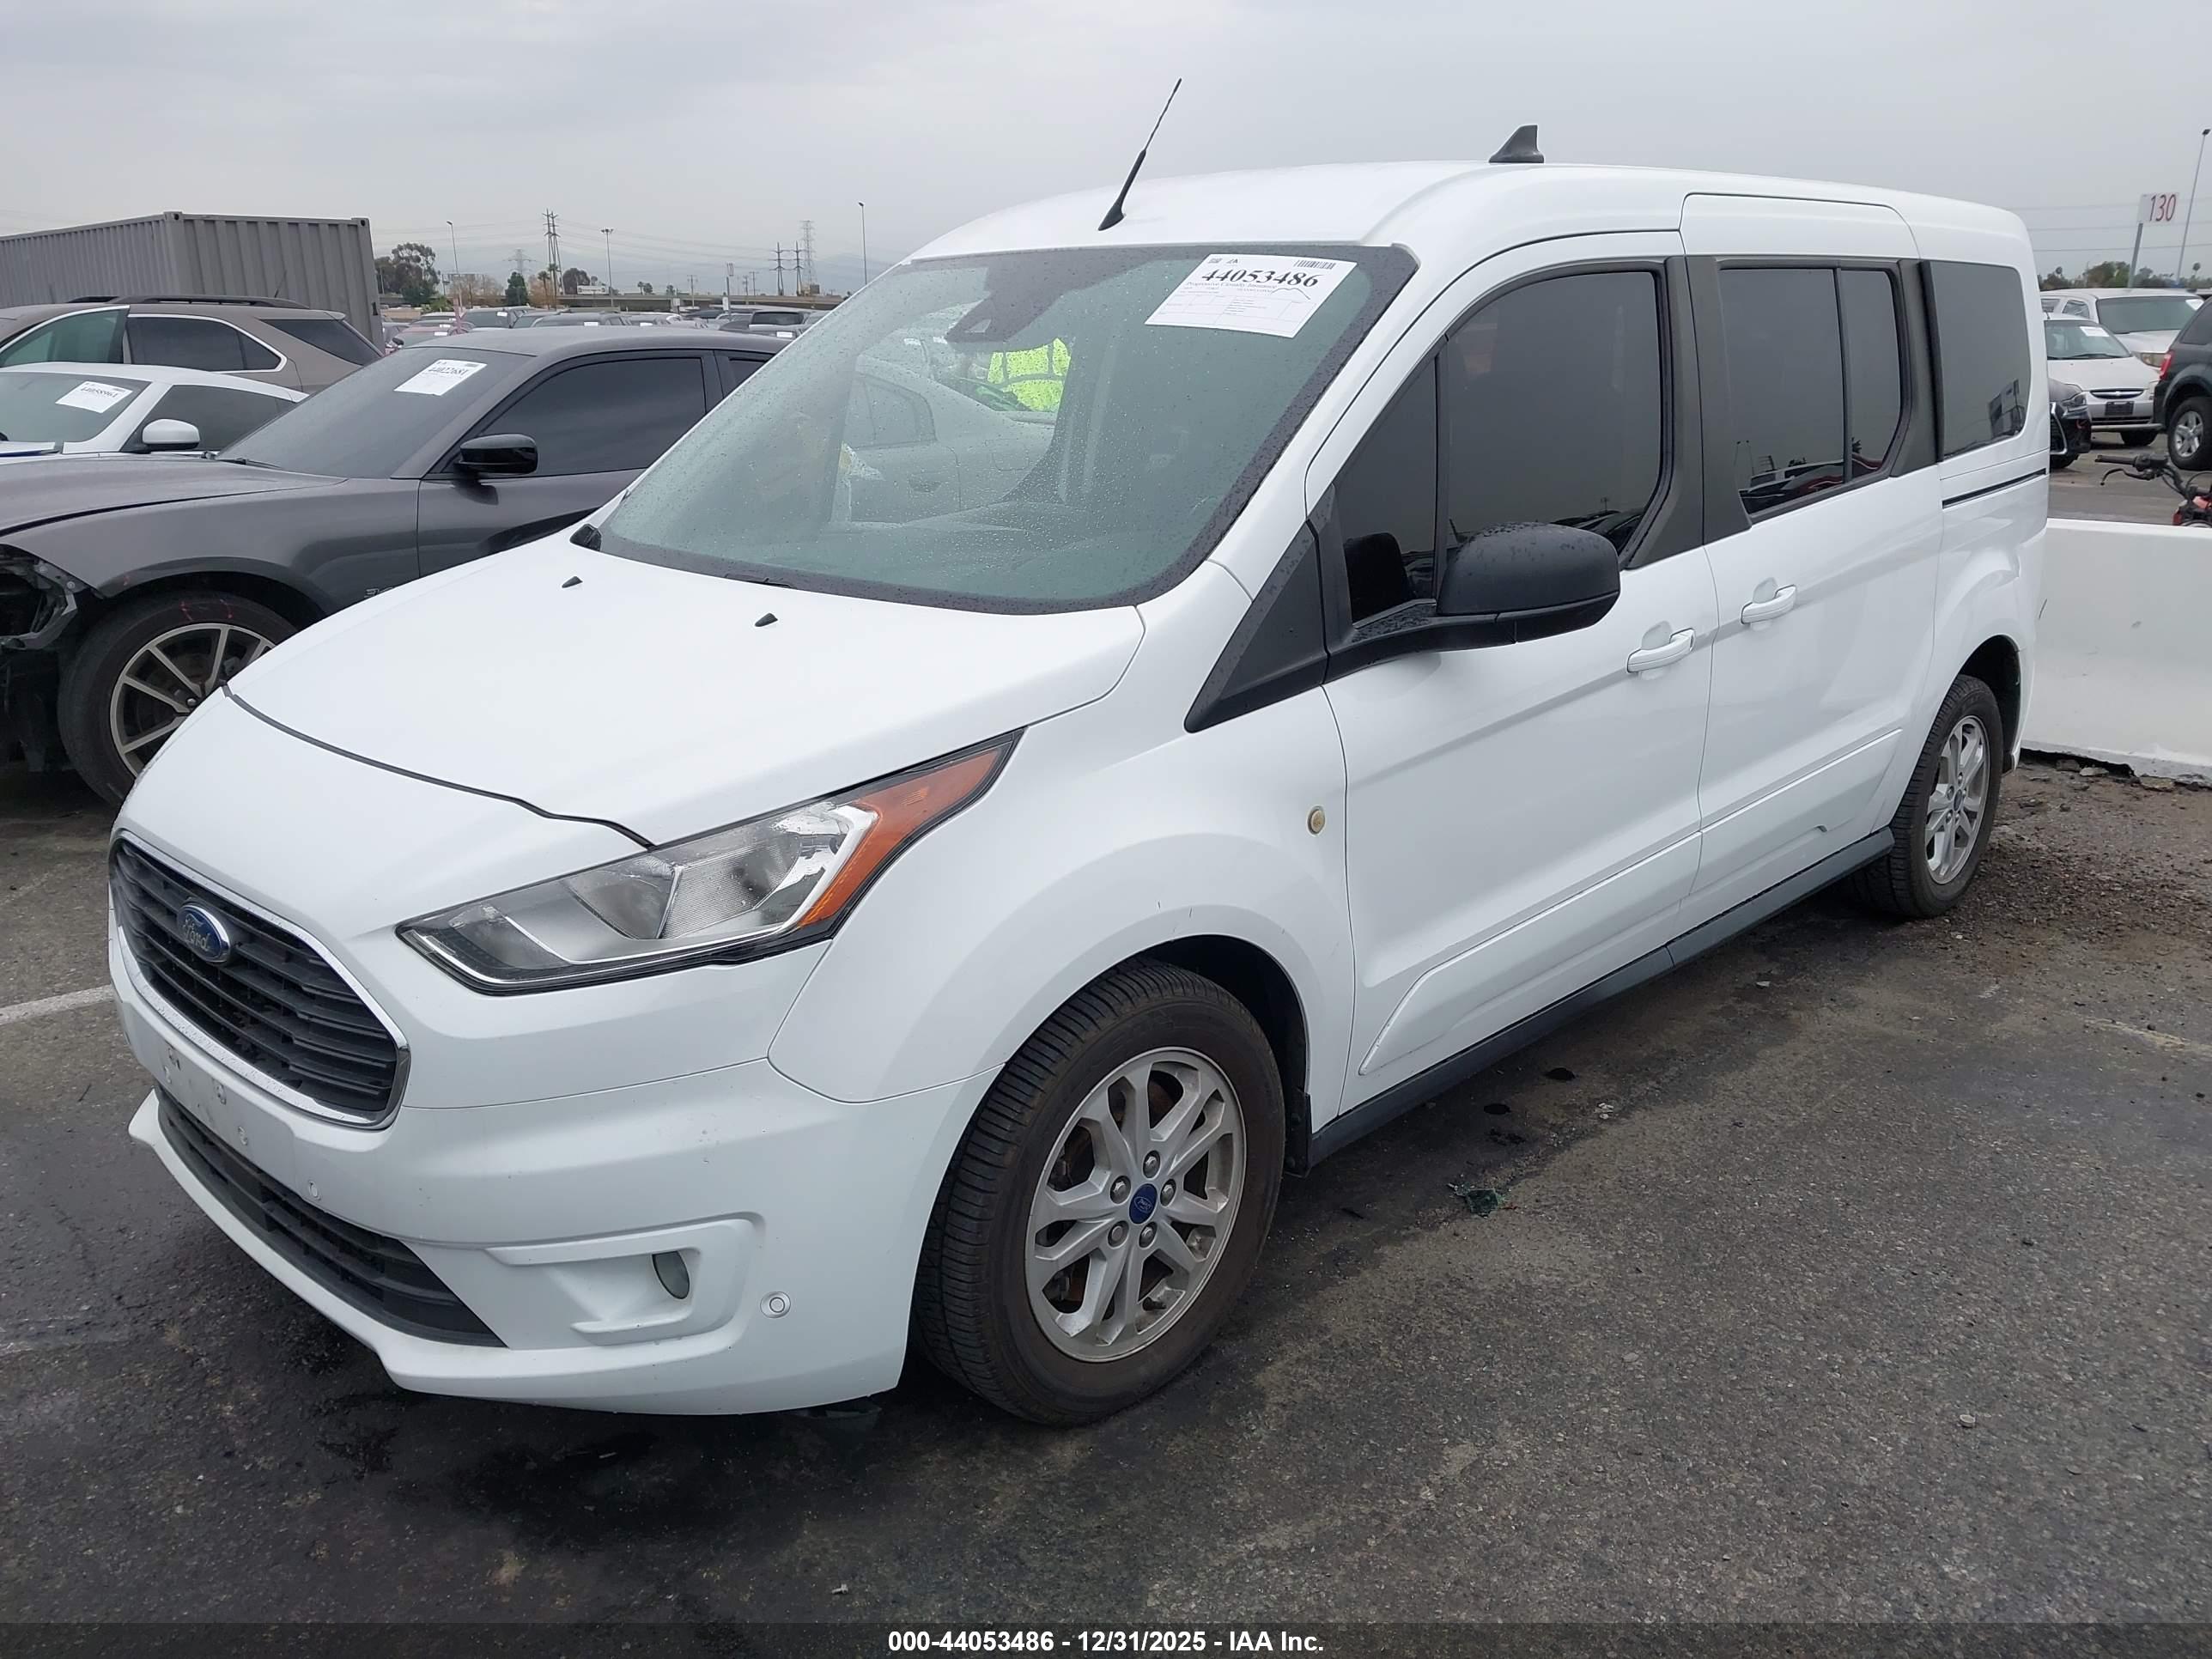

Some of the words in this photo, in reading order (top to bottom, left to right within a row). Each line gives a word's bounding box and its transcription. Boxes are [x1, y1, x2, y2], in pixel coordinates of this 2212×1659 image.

[2149, 194, 2177, 222] 130
[1201, 269, 1325, 288] 44053486
[183, 913, 211, 951] Ford
